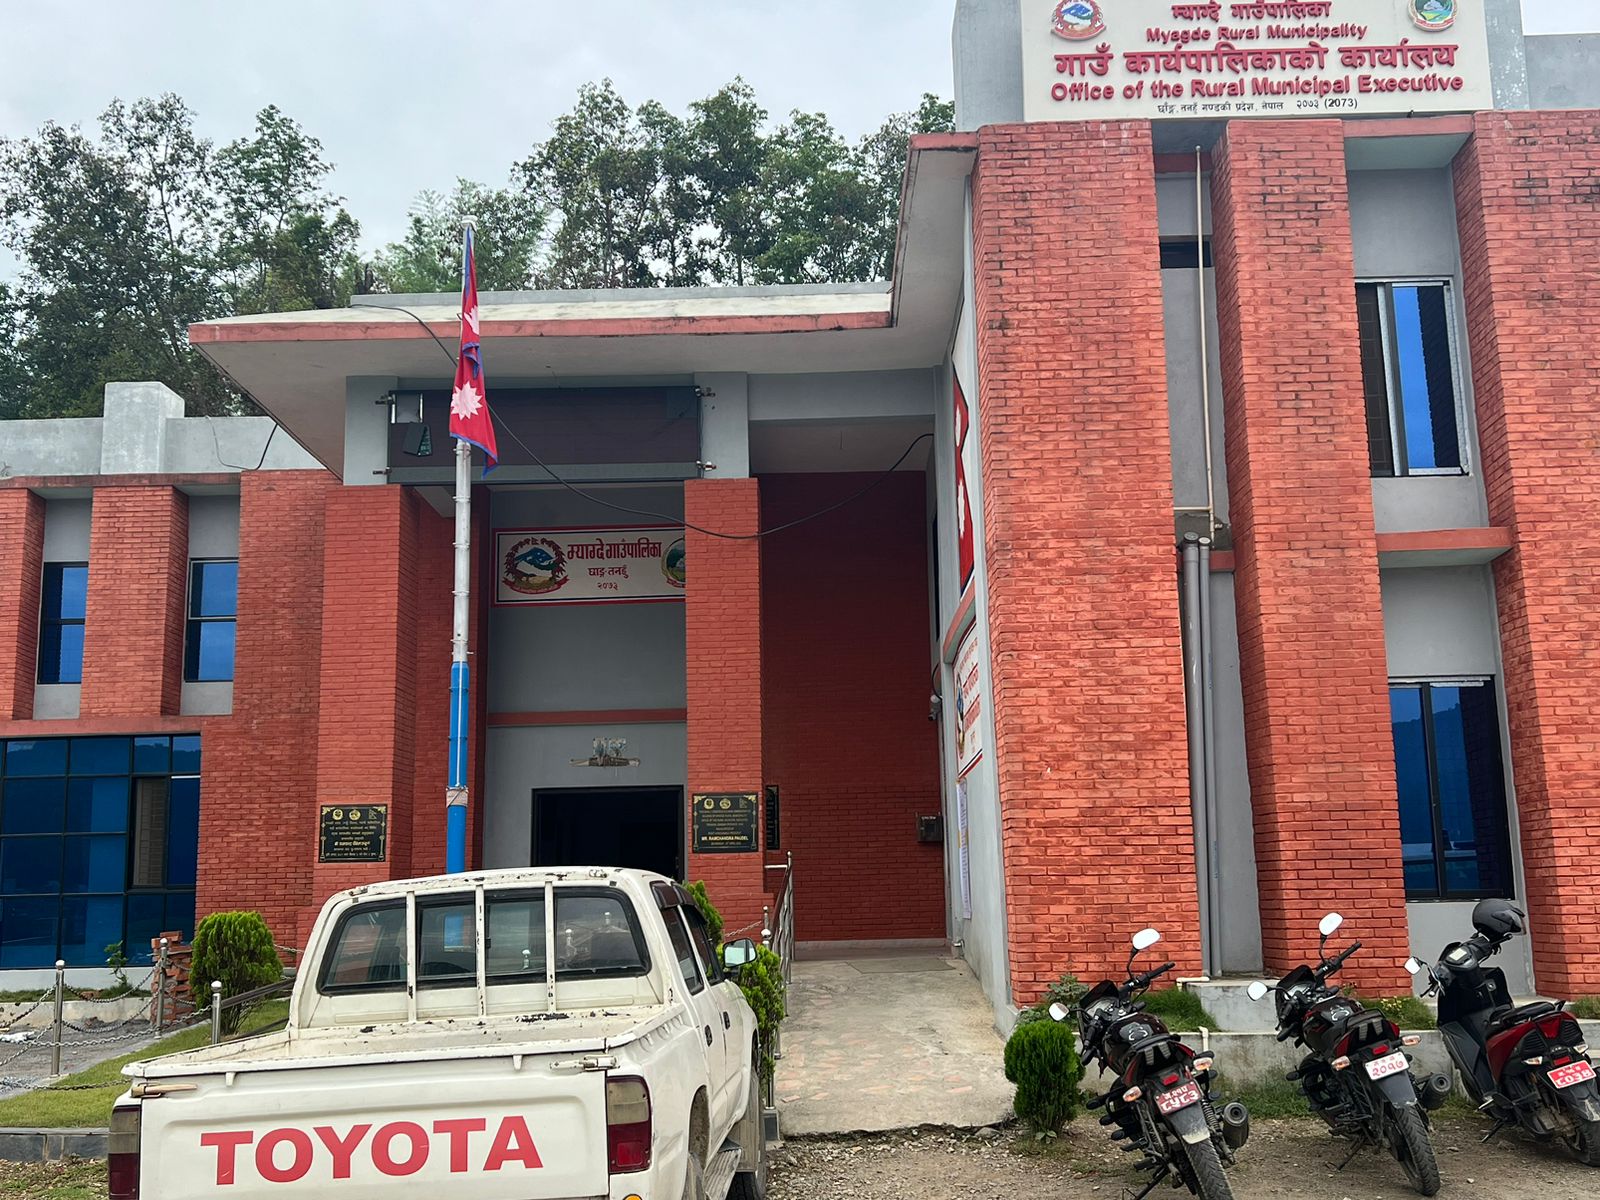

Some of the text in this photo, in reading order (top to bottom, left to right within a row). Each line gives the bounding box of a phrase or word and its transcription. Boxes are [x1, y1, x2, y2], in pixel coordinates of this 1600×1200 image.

[1171, 0, 1221, 22] म्याग्दे
[1146, 22, 1368, 44] Myagde Rural Municipality
[1053, 38, 1460, 77] गाउँ कार्यपालिकाको कार्यालय
[1051, 73, 1464, 101] Office of the Rural Municipal Executive
[1296, 99, 1320, 109] २०७३
[1324, 98, 1358, 109] (2073)
[567, 538, 604, 560] म्याग्दे
[597, 582, 618, 591] २०७३
[200, 1115, 544, 1186] TOYOTA
